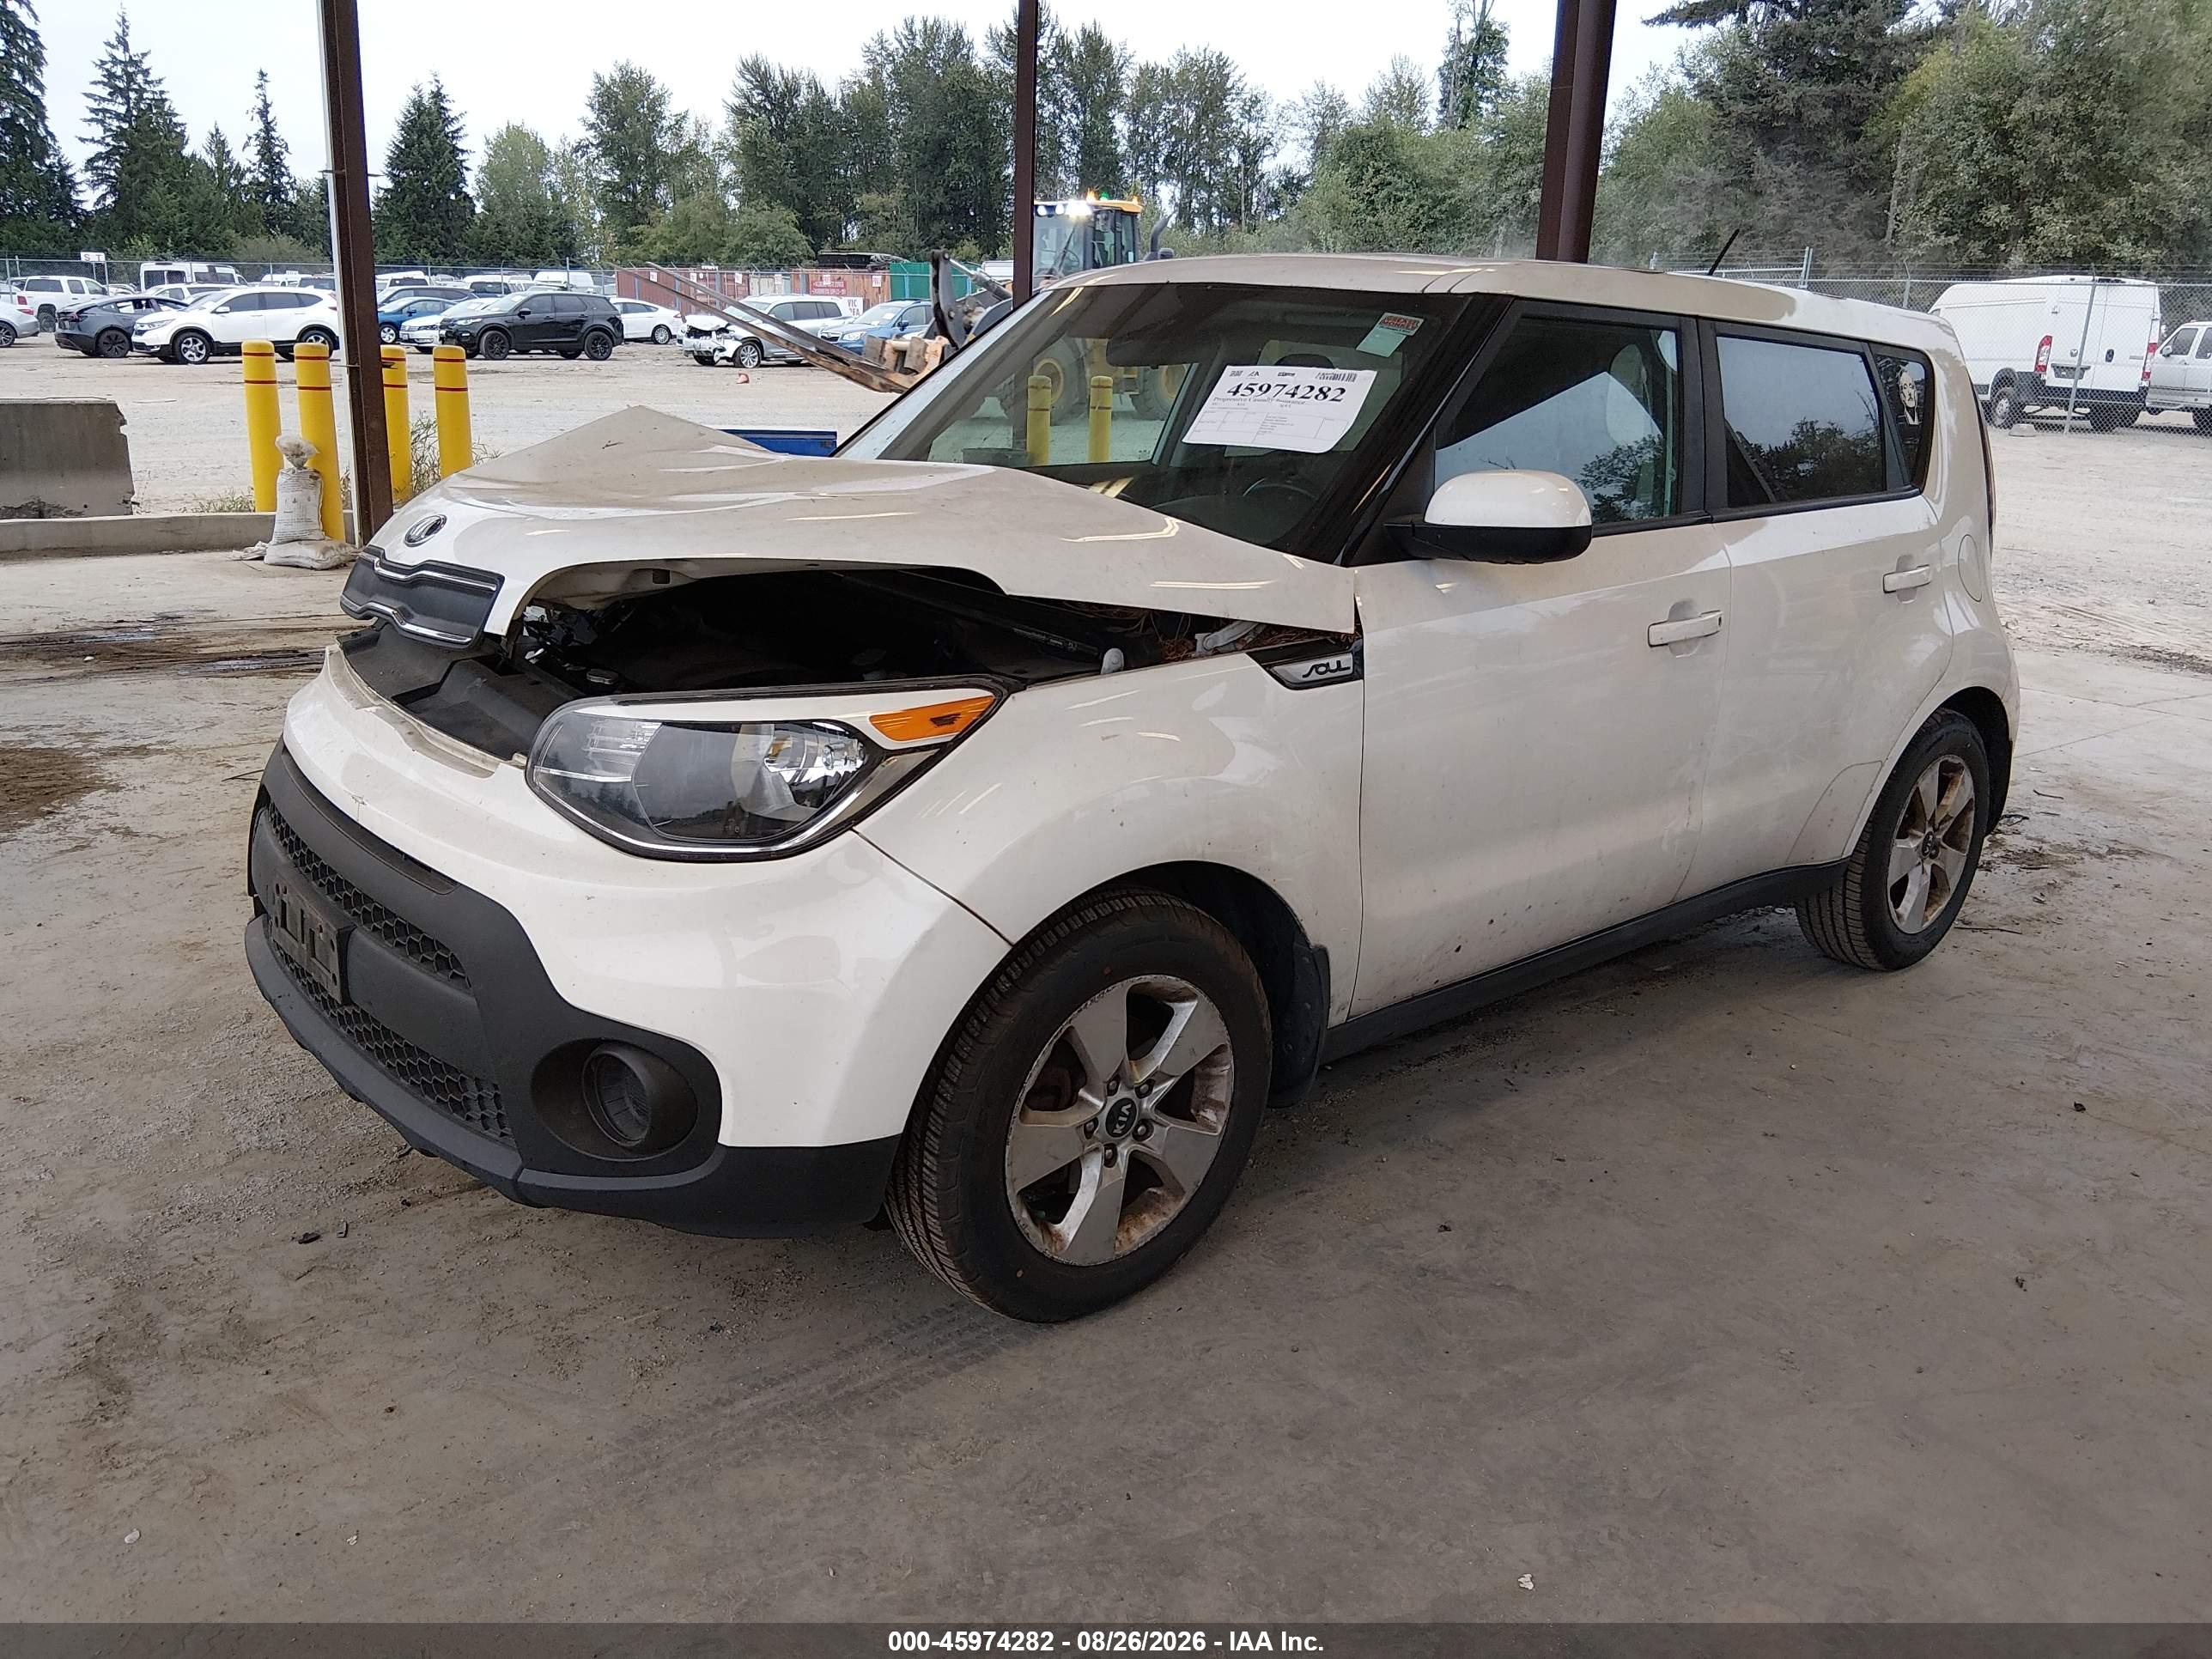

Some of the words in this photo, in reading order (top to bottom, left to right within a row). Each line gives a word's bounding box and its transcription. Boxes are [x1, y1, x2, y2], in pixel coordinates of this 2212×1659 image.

[1226, 382, 1346, 403] 45974282
[1302, 659, 1351, 678] SOUL
[1113, 1103, 1133, 1134] KIA
